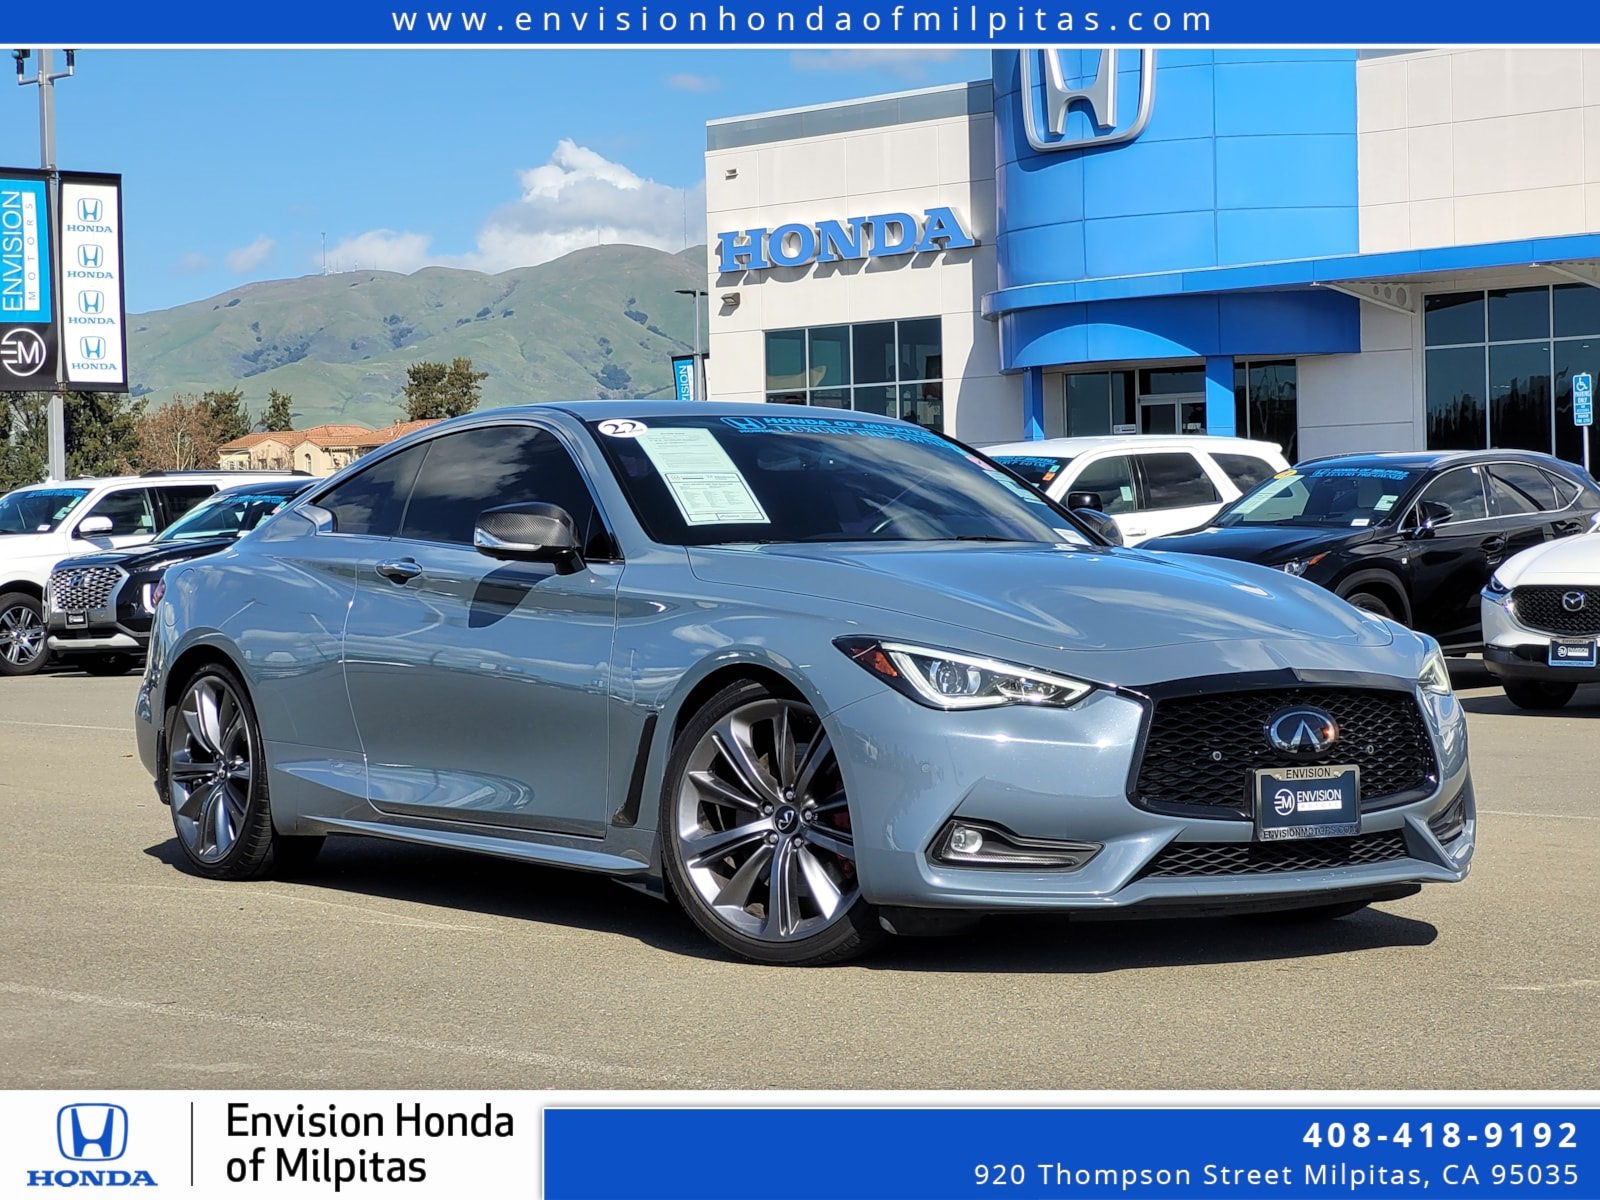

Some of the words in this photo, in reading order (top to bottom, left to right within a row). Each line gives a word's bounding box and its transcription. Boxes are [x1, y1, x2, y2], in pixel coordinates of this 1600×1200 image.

[67, 224, 113, 233] HONDA
[718, 206, 977, 273] HONDA
[1, 190, 24, 312] ENVISION
[25, 202, 37, 301] MOTORS
[67, 270, 114, 279] HONDA
[68, 316, 116, 325] HONDA
[71, 362, 118, 371] HONDA
[603, 421, 644, 434] 22
[763, 417, 832, 426] HONDA
[834, 420, 858, 428] OF
[776, 425, 853, 436] LUXURY
[1286, 768, 1331, 779] ENVISION
[1297, 789, 1342, 803] ENVISION
